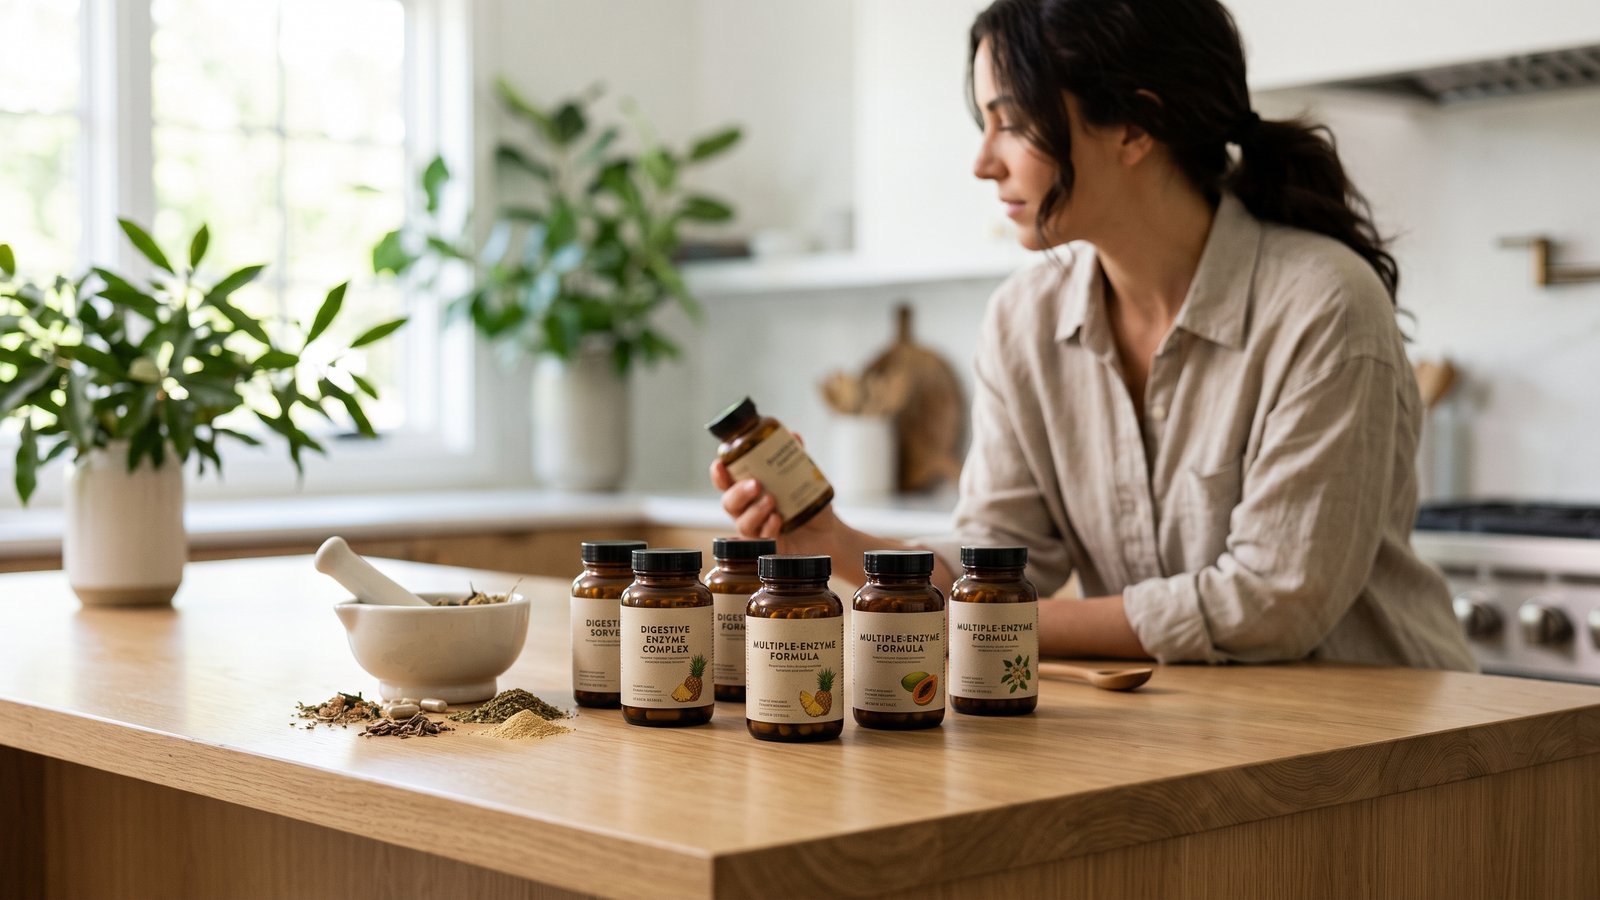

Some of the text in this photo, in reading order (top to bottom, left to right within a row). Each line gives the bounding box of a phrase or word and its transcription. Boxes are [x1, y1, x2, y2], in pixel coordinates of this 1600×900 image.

[717, 613, 746, 622] DIGES
[641, 625, 690, 634] DIGESTIVE
[646, 635, 686, 644] ENZYME
[972, 634, 1018, 642] FORMULA
[642, 645, 689, 653] COMPLEX
[876, 644, 924, 653] FORMULA
[770, 652, 819, 661] FORMULA
